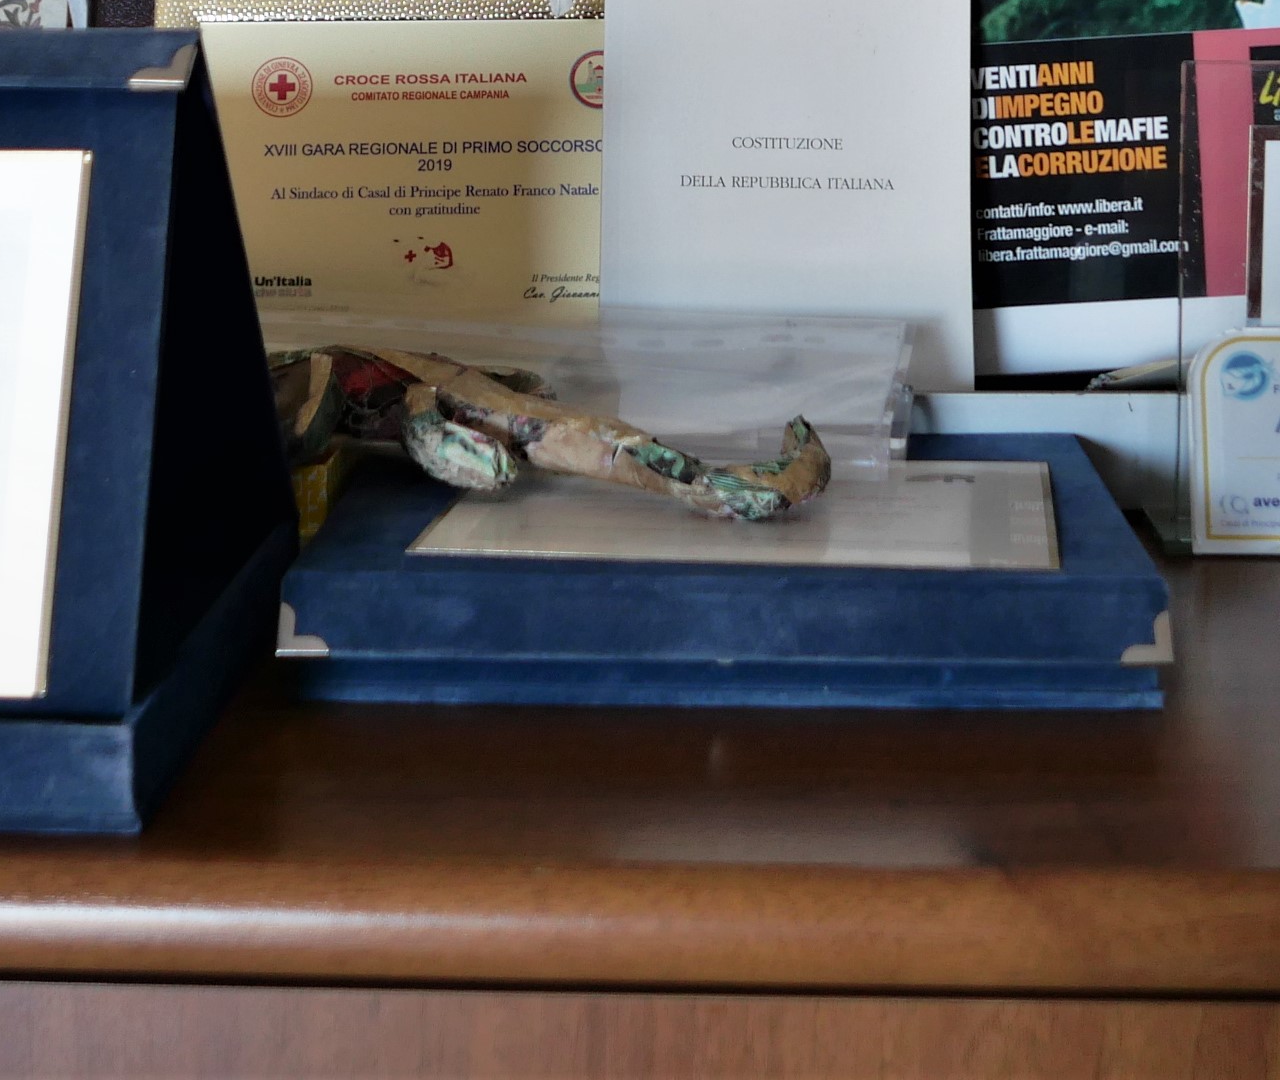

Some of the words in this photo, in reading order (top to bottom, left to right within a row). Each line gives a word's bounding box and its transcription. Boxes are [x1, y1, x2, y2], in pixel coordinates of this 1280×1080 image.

[333, 74, 391, 86] CROCE
[395, 73, 451, 85] ROSSA
[454, 72, 527, 84] ITALIANA
[351, 91, 399, 102] COMITATO
[401, 90, 459, 101] REGIONALE
[460, 89, 510, 100] CAMPANIA
[264, 144, 298, 157] XVIII
[301, 143, 345, 157] GARA
[348, 142, 438, 156] REGIONALE
[442, 141, 458, 155] DI
[462, 141, 512, 154] PRIMO
[731, 136, 843, 150] COSTITUZIONE
[417, 158, 453, 172] 2019
[680, 175, 725, 188] DELLA
[731, 175, 822, 189] REPUBBLICA
[827, 177, 894, 190] ITALIANA
[271, 187, 286, 200] Al
[289, 186, 339, 200] Sindaco
[341, 186, 354, 199] di
[357, 186, 391, 199] Casal
[394, 186, 406, 199] di
[410, 185, 461, 201] Principe
[464, 185, 509, 198] Renato
[512, 184, 556, 197] Franco
[559, 184, 600, 196] Natale
[388, 206, 412, 216] con
[414, 202, 481, 218] gratitudine
[1057, 196, 1143, 216] www.libera.it
[1084, 220, 1129, 236] e-mail:
